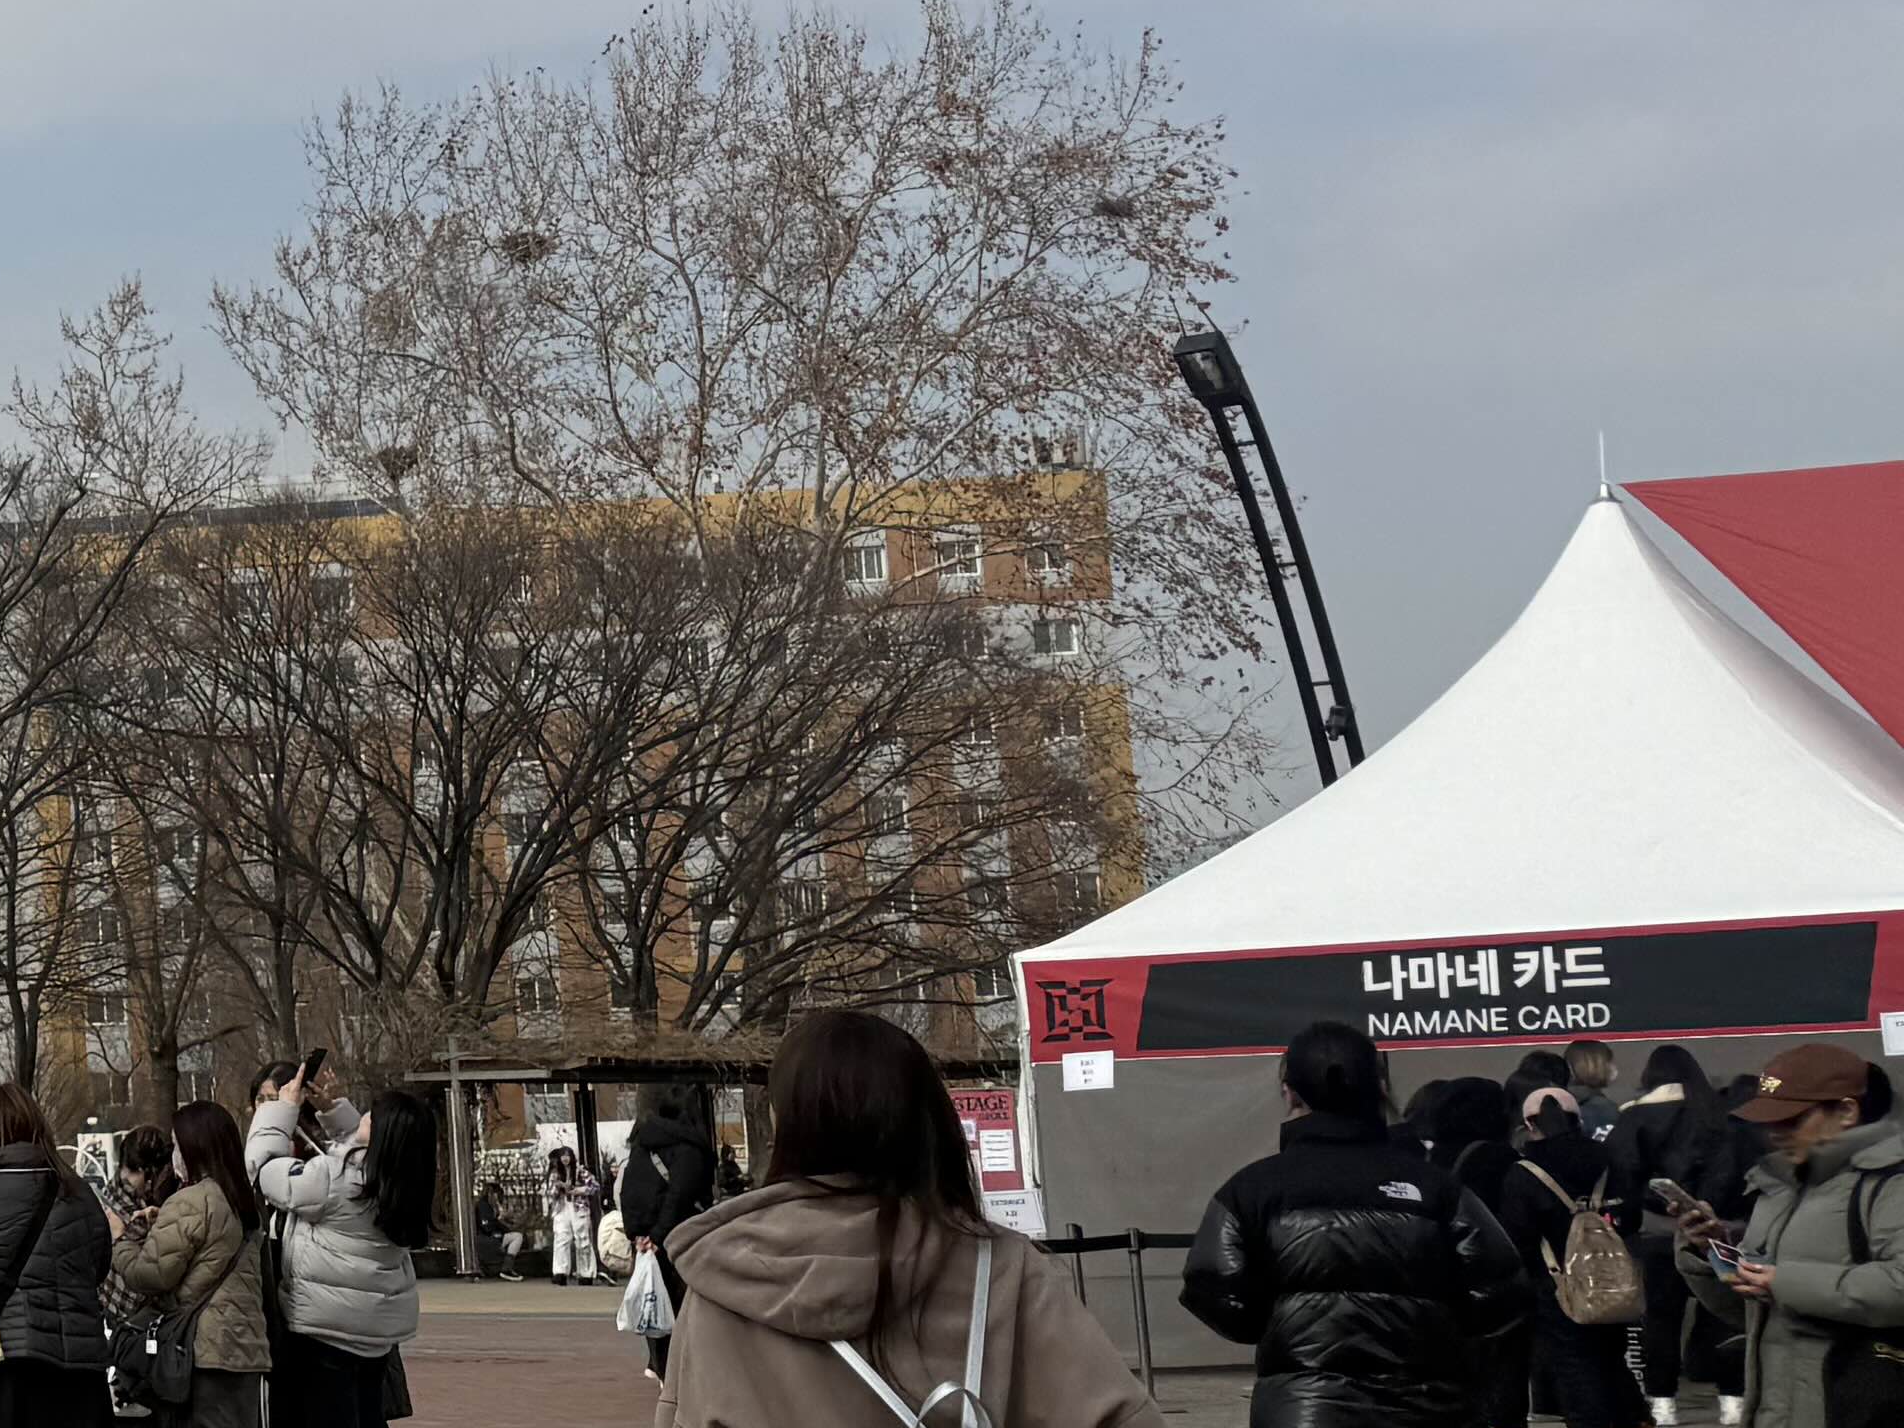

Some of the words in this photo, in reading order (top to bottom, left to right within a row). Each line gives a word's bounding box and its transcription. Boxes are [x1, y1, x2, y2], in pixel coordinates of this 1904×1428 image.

[1362, 948, 1500, 1001] 나마네
[1512, 945, 1611, 994] 카드
[1368, 1007, 1509, 1037] NAMANE
[1517, 1002, 1611, 1030] CARD
